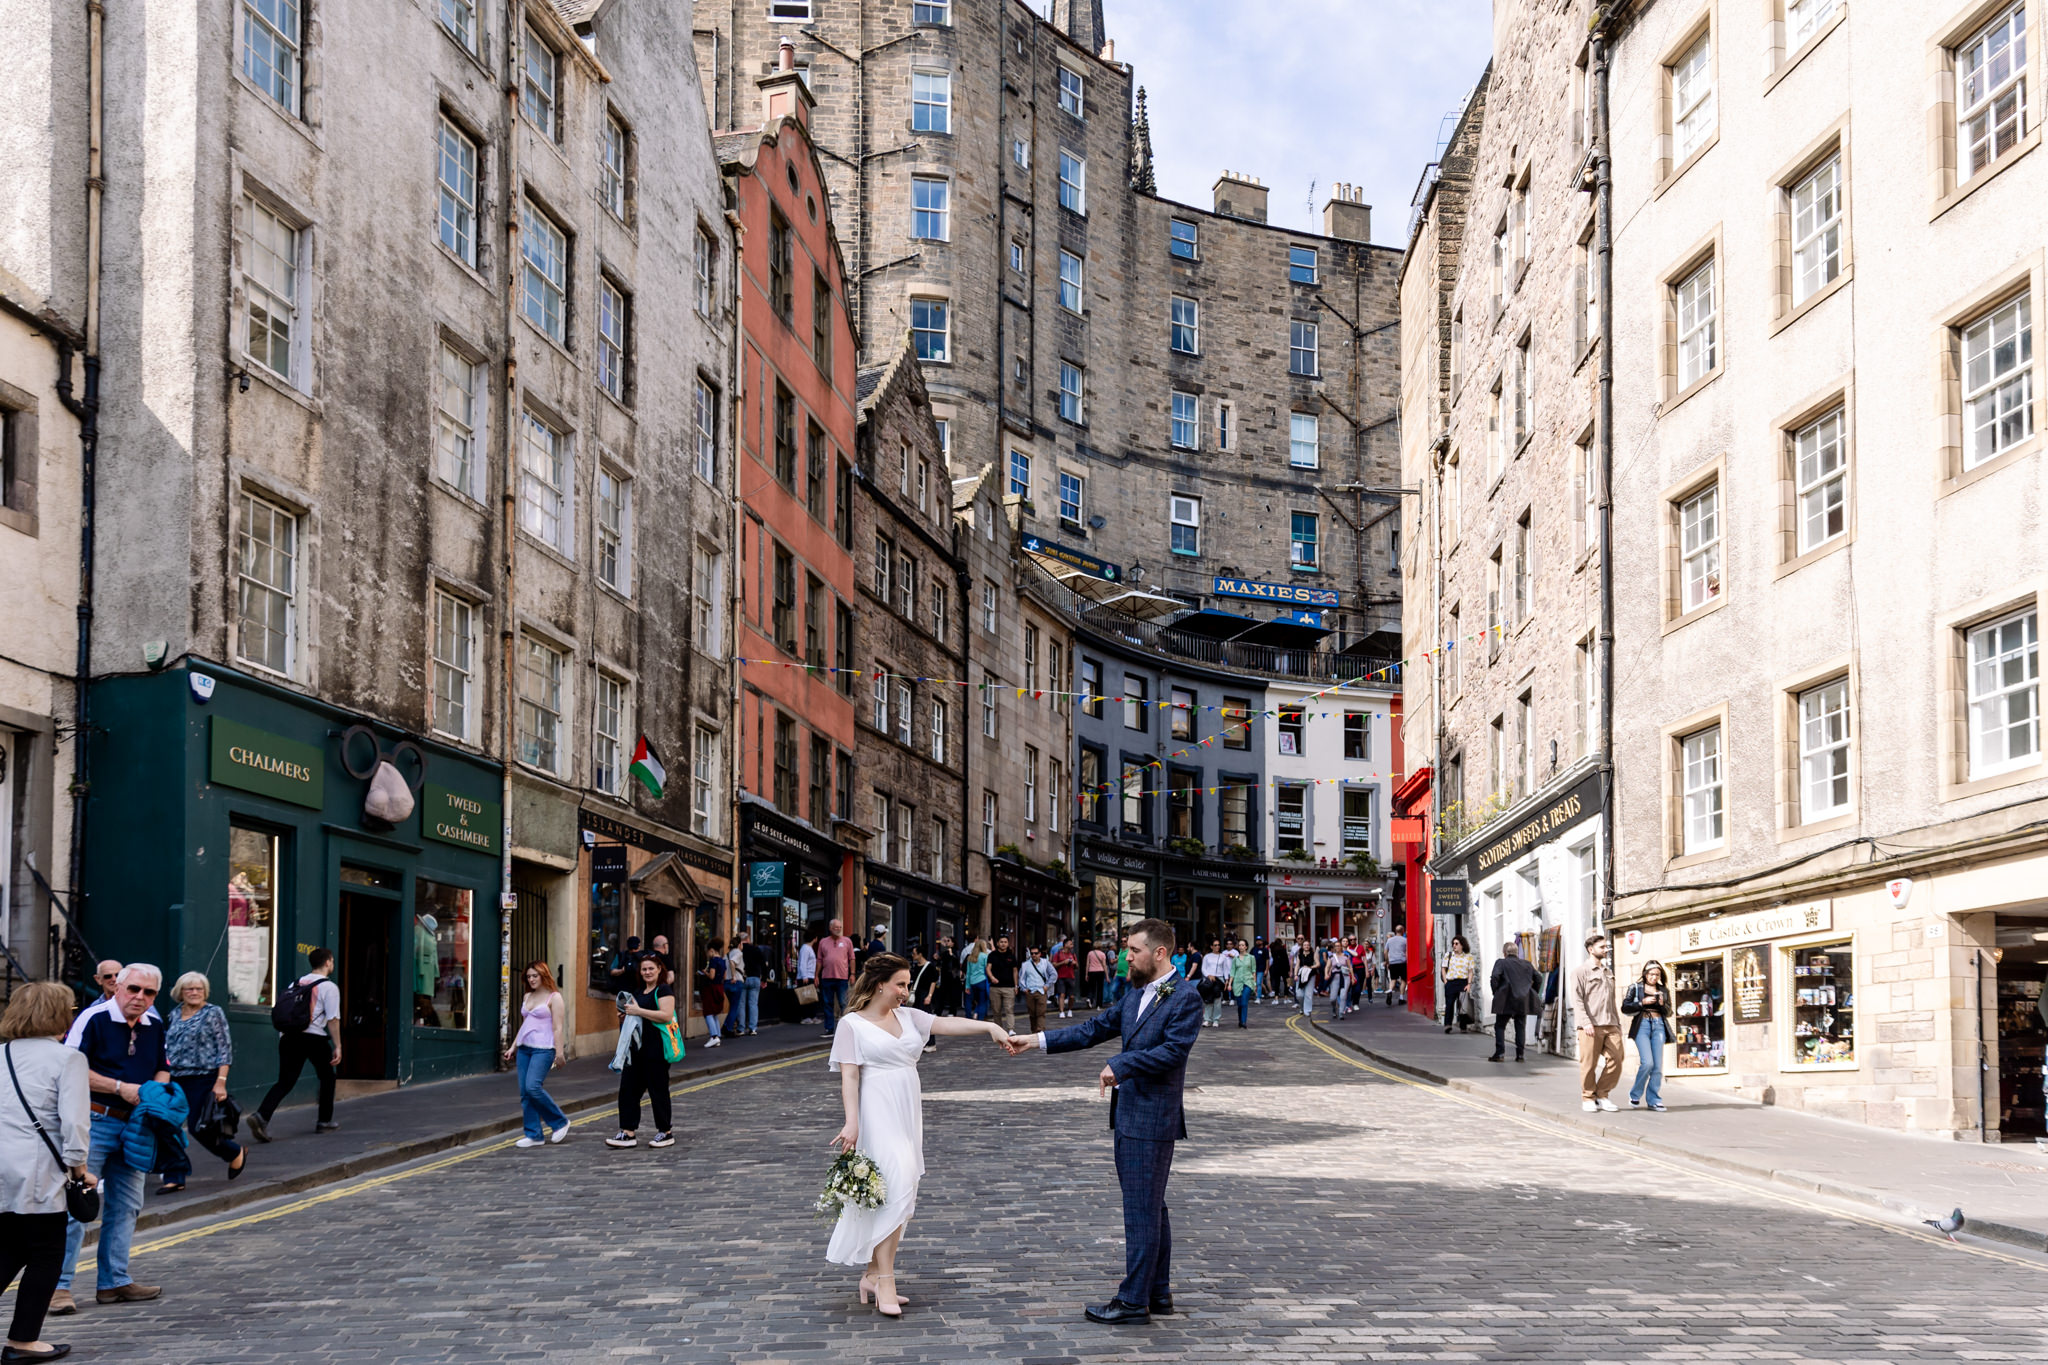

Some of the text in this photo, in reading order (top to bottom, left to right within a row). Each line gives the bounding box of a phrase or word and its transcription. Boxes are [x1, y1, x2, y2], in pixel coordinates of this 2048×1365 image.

[1218, 580, 1310, 601] MAXIES
[229, 746, 311, 782] CHALMERS
[446, 793, 481, 815] TWEED
[459, 813, 468, 827] &
[1478, 794, 1581, 871] SCOTTISH SWEETS & TREATS
[436, 823, 490, 848] CASHMERE
[585, 813, 645, 844] ISLANDER
[710, 859, 729, 874] STORE
[761, 824, 769, 833] OF
[769, 828, 783, 841] SKYE
[783, 834, 802, 849] CANDLE
[1097, 852, 1147, 870] Walker Slater
[1192, 869, 1230, 880] LADIESWEAR
[1708, 916, 1793, 941] Castle & Crown
